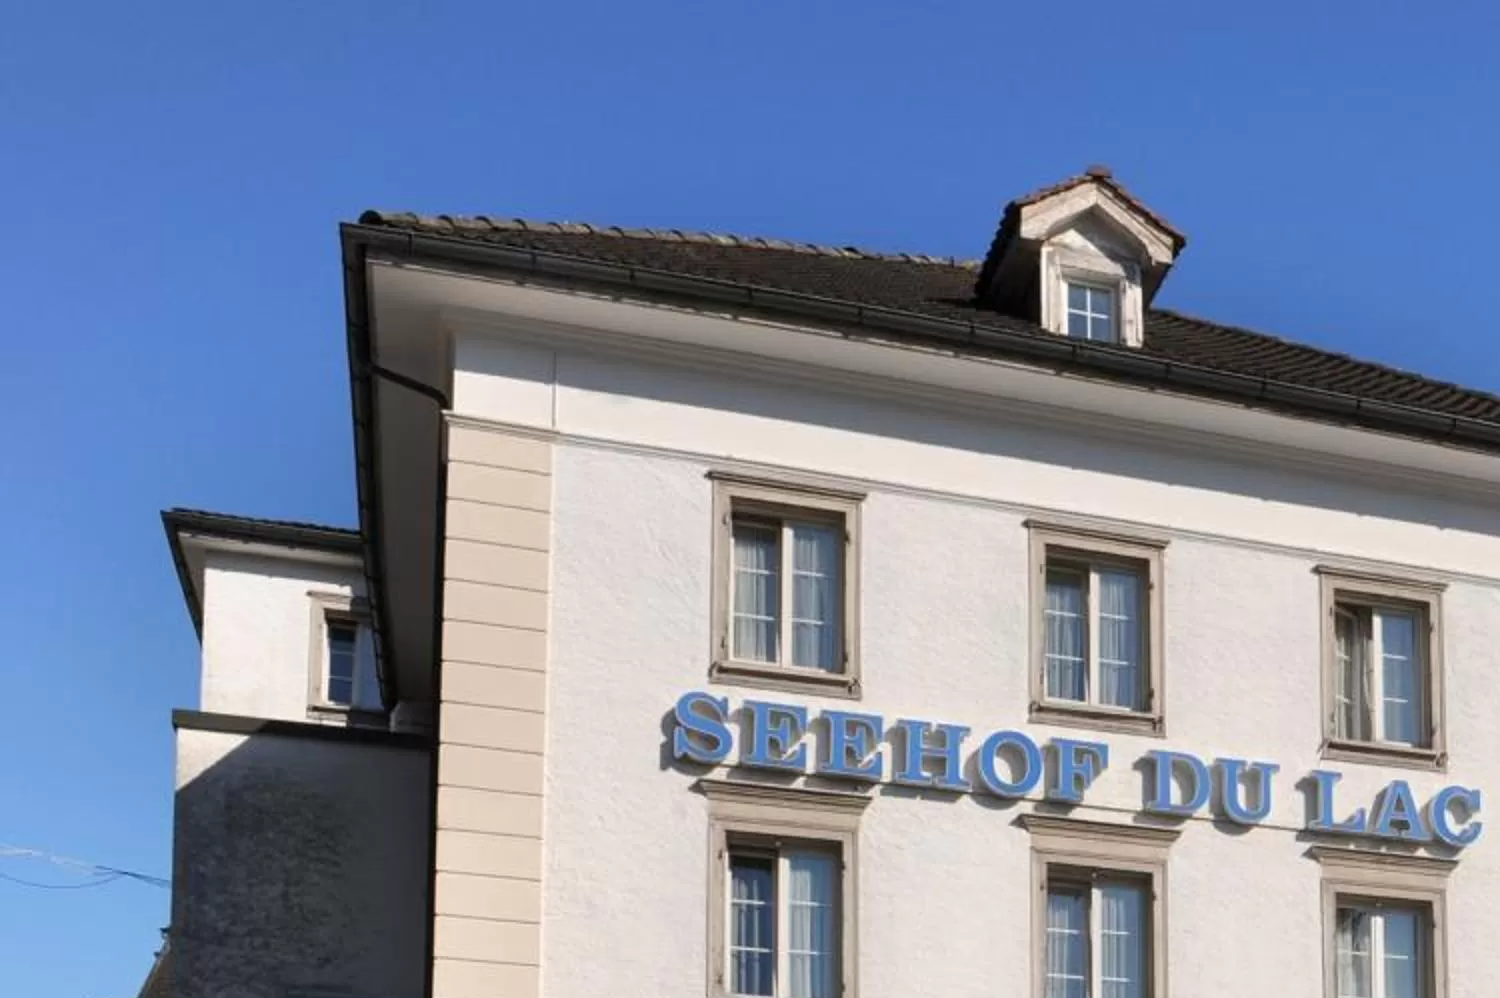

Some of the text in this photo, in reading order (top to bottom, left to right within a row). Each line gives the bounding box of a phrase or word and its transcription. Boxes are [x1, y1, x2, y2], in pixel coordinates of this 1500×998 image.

[674, 690, 1483, 847] SEEHOF DU LAC
